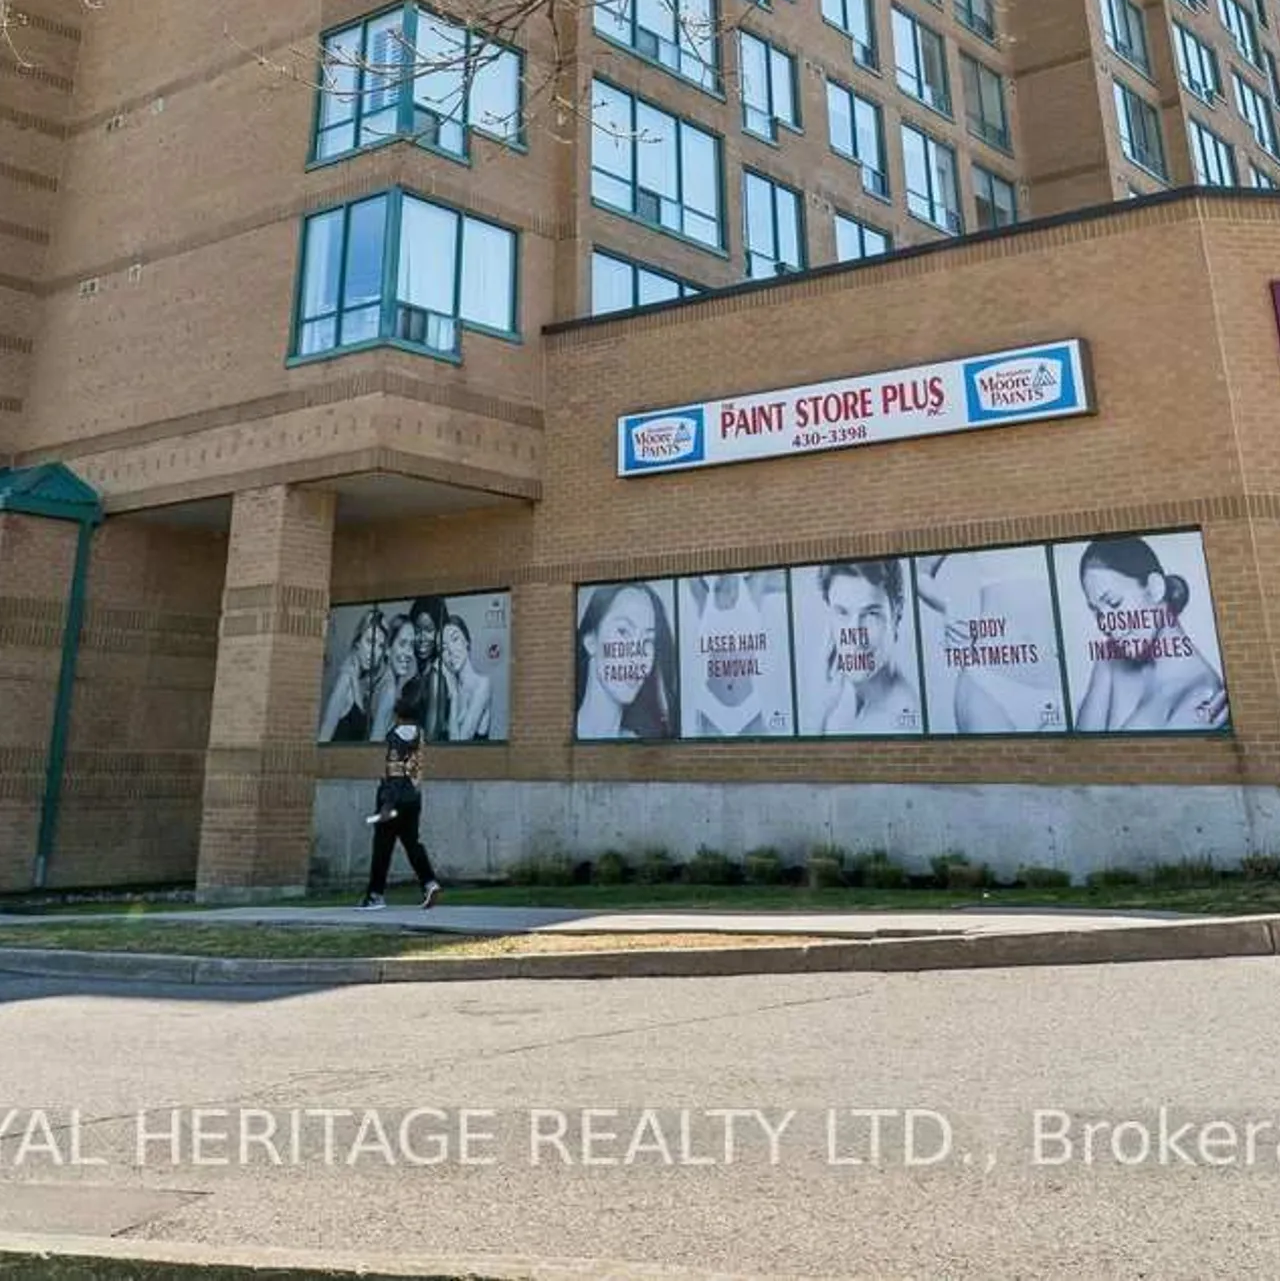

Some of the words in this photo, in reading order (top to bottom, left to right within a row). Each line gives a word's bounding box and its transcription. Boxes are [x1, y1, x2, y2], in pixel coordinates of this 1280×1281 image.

[980, 375, 1030, 393] Moore
[720, 401, 787, 440] PAINT
[794, 387, 874, 428] STORE
[880, 375, 945, 415] PLUS
[991, 388, 1045, 407] PAINTS
[634, 431, 673, 446] Moore
[791, 425, 868, 449] 430-3398
[641, 442, 681, 458] PAINTS
[970, 618, 1007, 638] BODY
[1096, 606, 1179, 632] COSMETIC
[700, 635, 736, 653] LASER
[738, 633, 768, 652] HAIR
[839, 627, 870, 647] ANTI
[603, 637, 652, 658] MEDICAL
[944, 644, 1039, 668] TREATMENTS
[1088, 636, 1193, 662] INJECTABLES
[706, 659, 762, 678] REMOVAL
[836, 652, 875, 672] AGING
[604, 663, 648, 682] FACIALS
